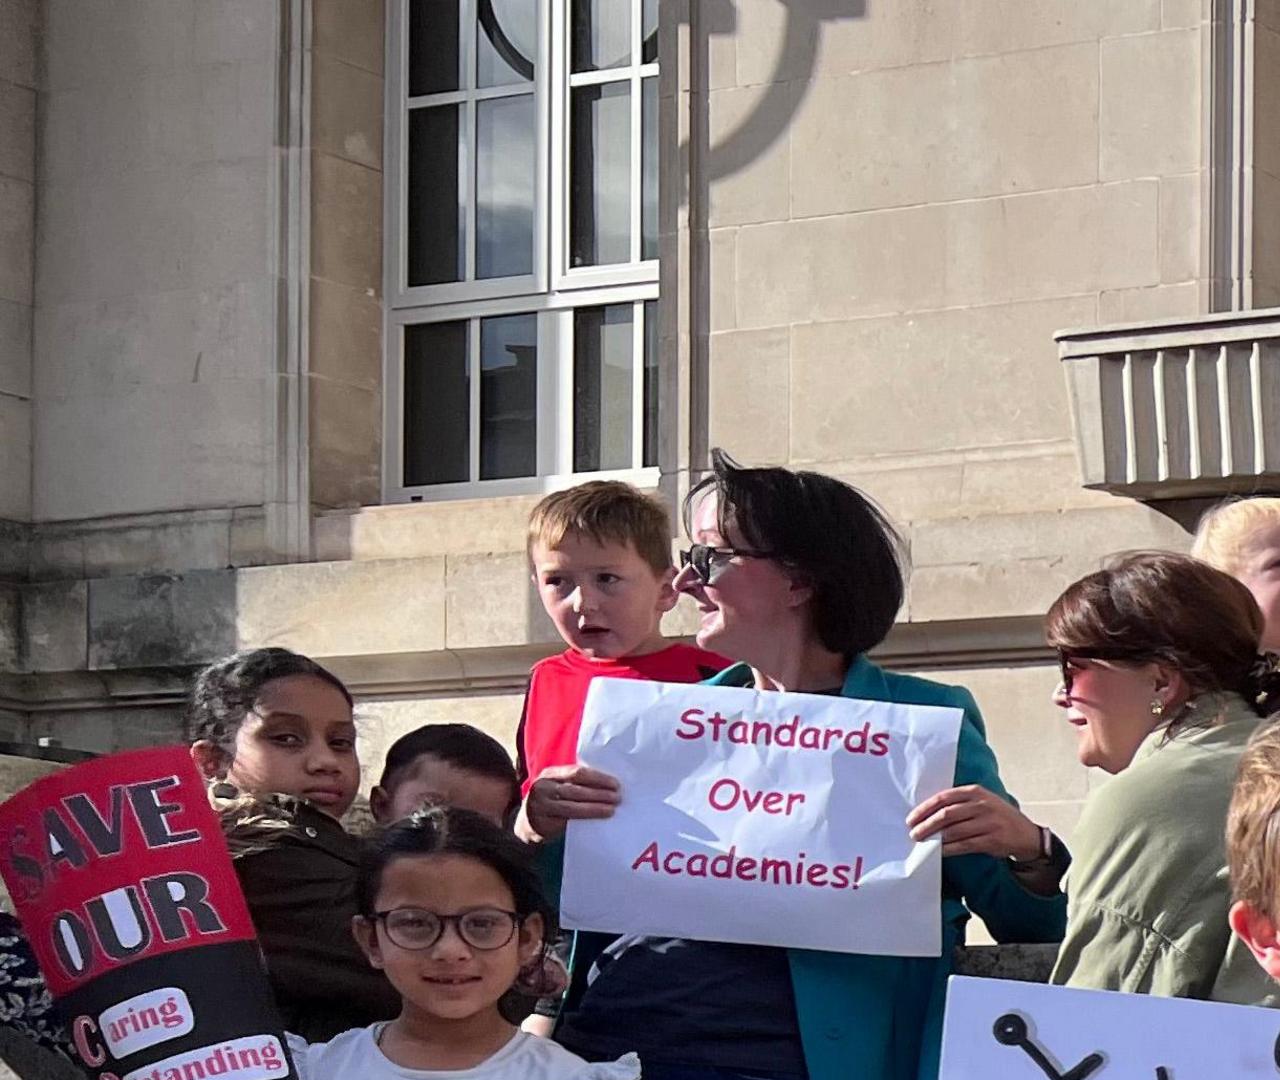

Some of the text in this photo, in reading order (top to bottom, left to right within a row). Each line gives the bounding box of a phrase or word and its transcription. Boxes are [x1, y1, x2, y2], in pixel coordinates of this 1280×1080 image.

[675, 708, 891, 757] Standards
[707, 777, 806, 818] Over
[8, 775, 202, 902] SAVE
[631, 840, 864, 891] Academies!
[52, 871, 229, 981] OUR
[72, 996, 186, 1068] Caring
